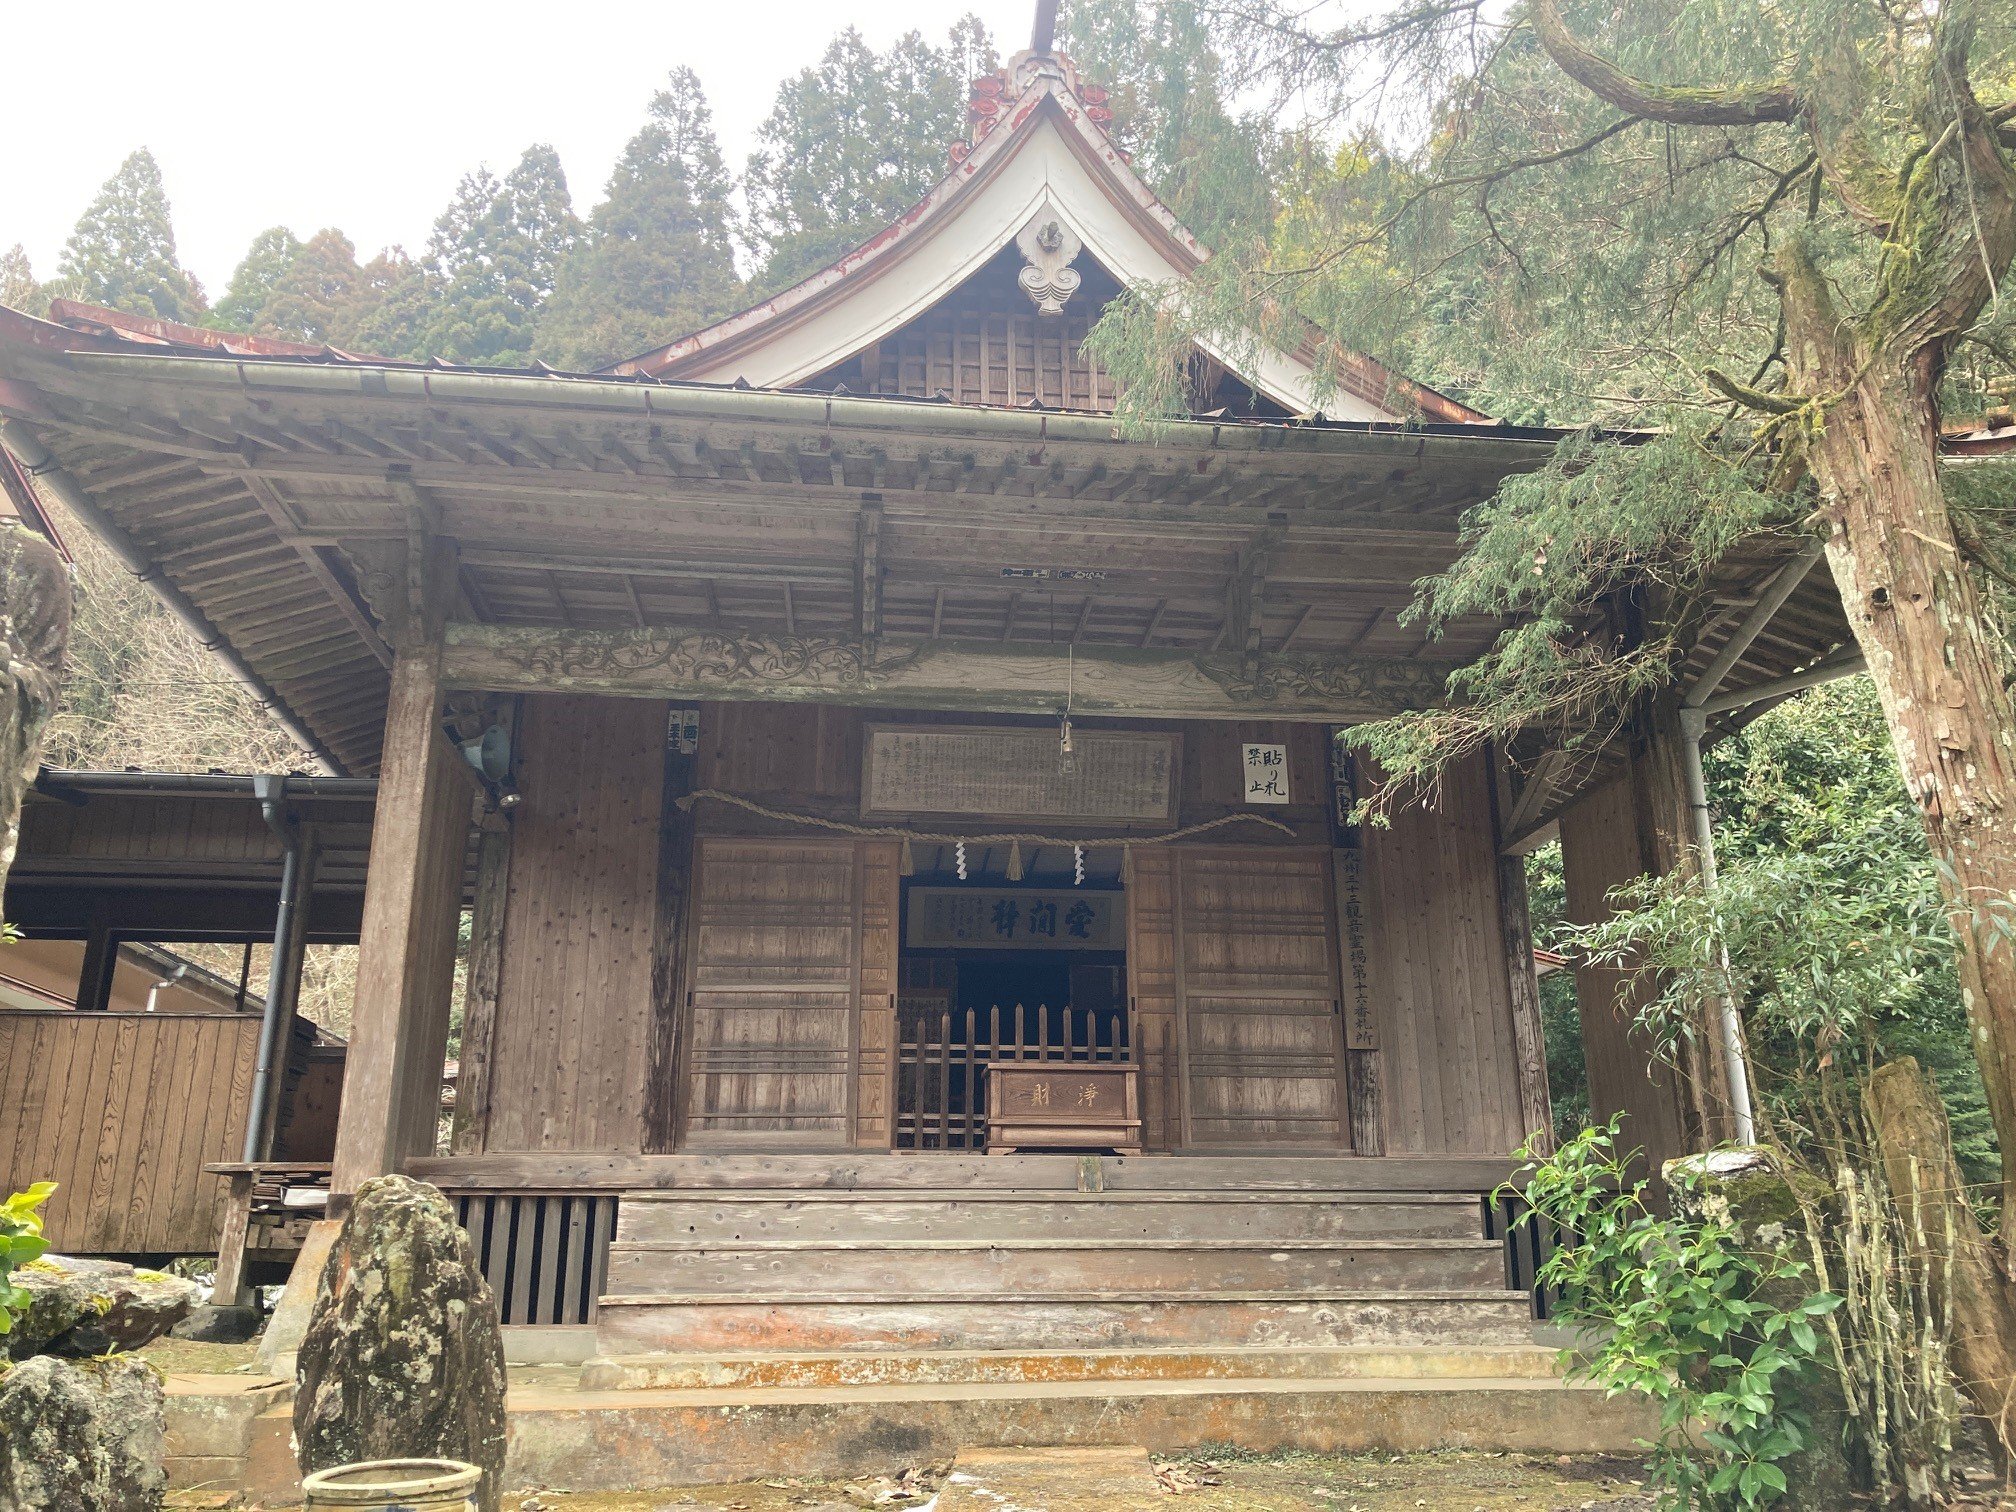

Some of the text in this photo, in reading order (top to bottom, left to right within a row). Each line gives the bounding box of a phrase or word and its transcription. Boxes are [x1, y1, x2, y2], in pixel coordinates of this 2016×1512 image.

[1248, 748, 1265, 792] 禁止
[1263, 750, 1286, 796] 貼り札
